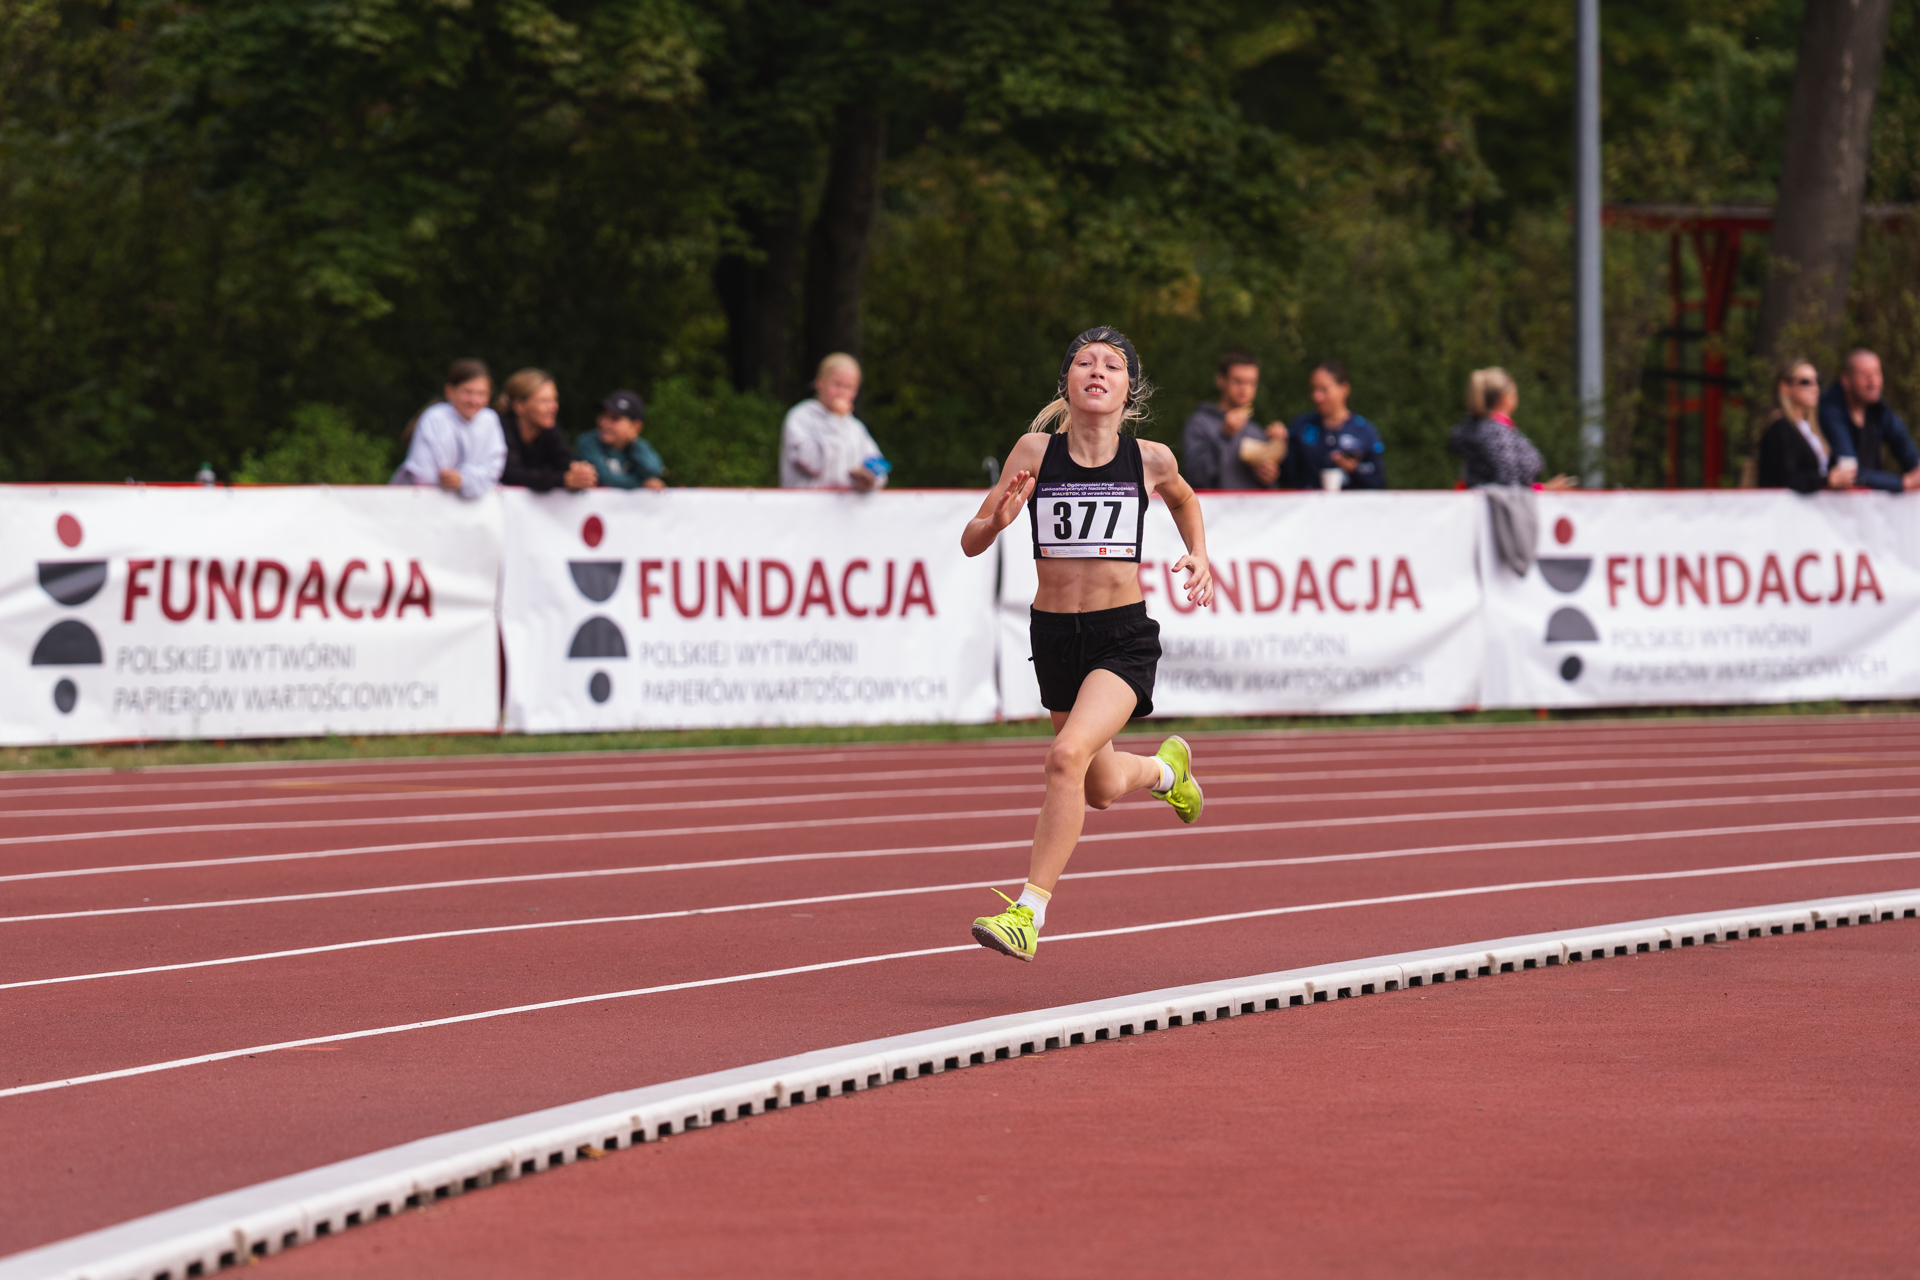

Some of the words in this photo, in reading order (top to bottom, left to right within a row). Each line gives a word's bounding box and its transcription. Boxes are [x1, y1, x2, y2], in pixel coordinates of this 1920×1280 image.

[1053, 501, 1122, 540] 377
[123, 557, 434, 622] FUNDACJA
[639, 558, 937, 619] FUNDACJA
[1138, 556, 1423, 616] FUNDACJA
[1606, 551, 1884, 608] FUNDACJA
[639, 639, 730, 669] POLSKIEJ
[734, 632, 859, 667] WYTWÓRNI
[1161, 633, 1227, 662] LSKIEJ
[1610, 626, 1696, 649] POLSKIEJ
[1700, 622, 1813, 646] WYTWÓRNI
[115, 644, 221, 675] POLSKIEJ
[226, 637, 357, 672] WYTWÓRNI
[112, 678, 238, 716] PAPIERÓW
[242, 675, 439, 711] WARTOŚCIOWYCH
[640, 672, 747, 707] PAPIERÓW
[751, 669, 949, 705] WARTOŚCIOWYCH
[1156, 664, 1236, 695] PIERÓW
